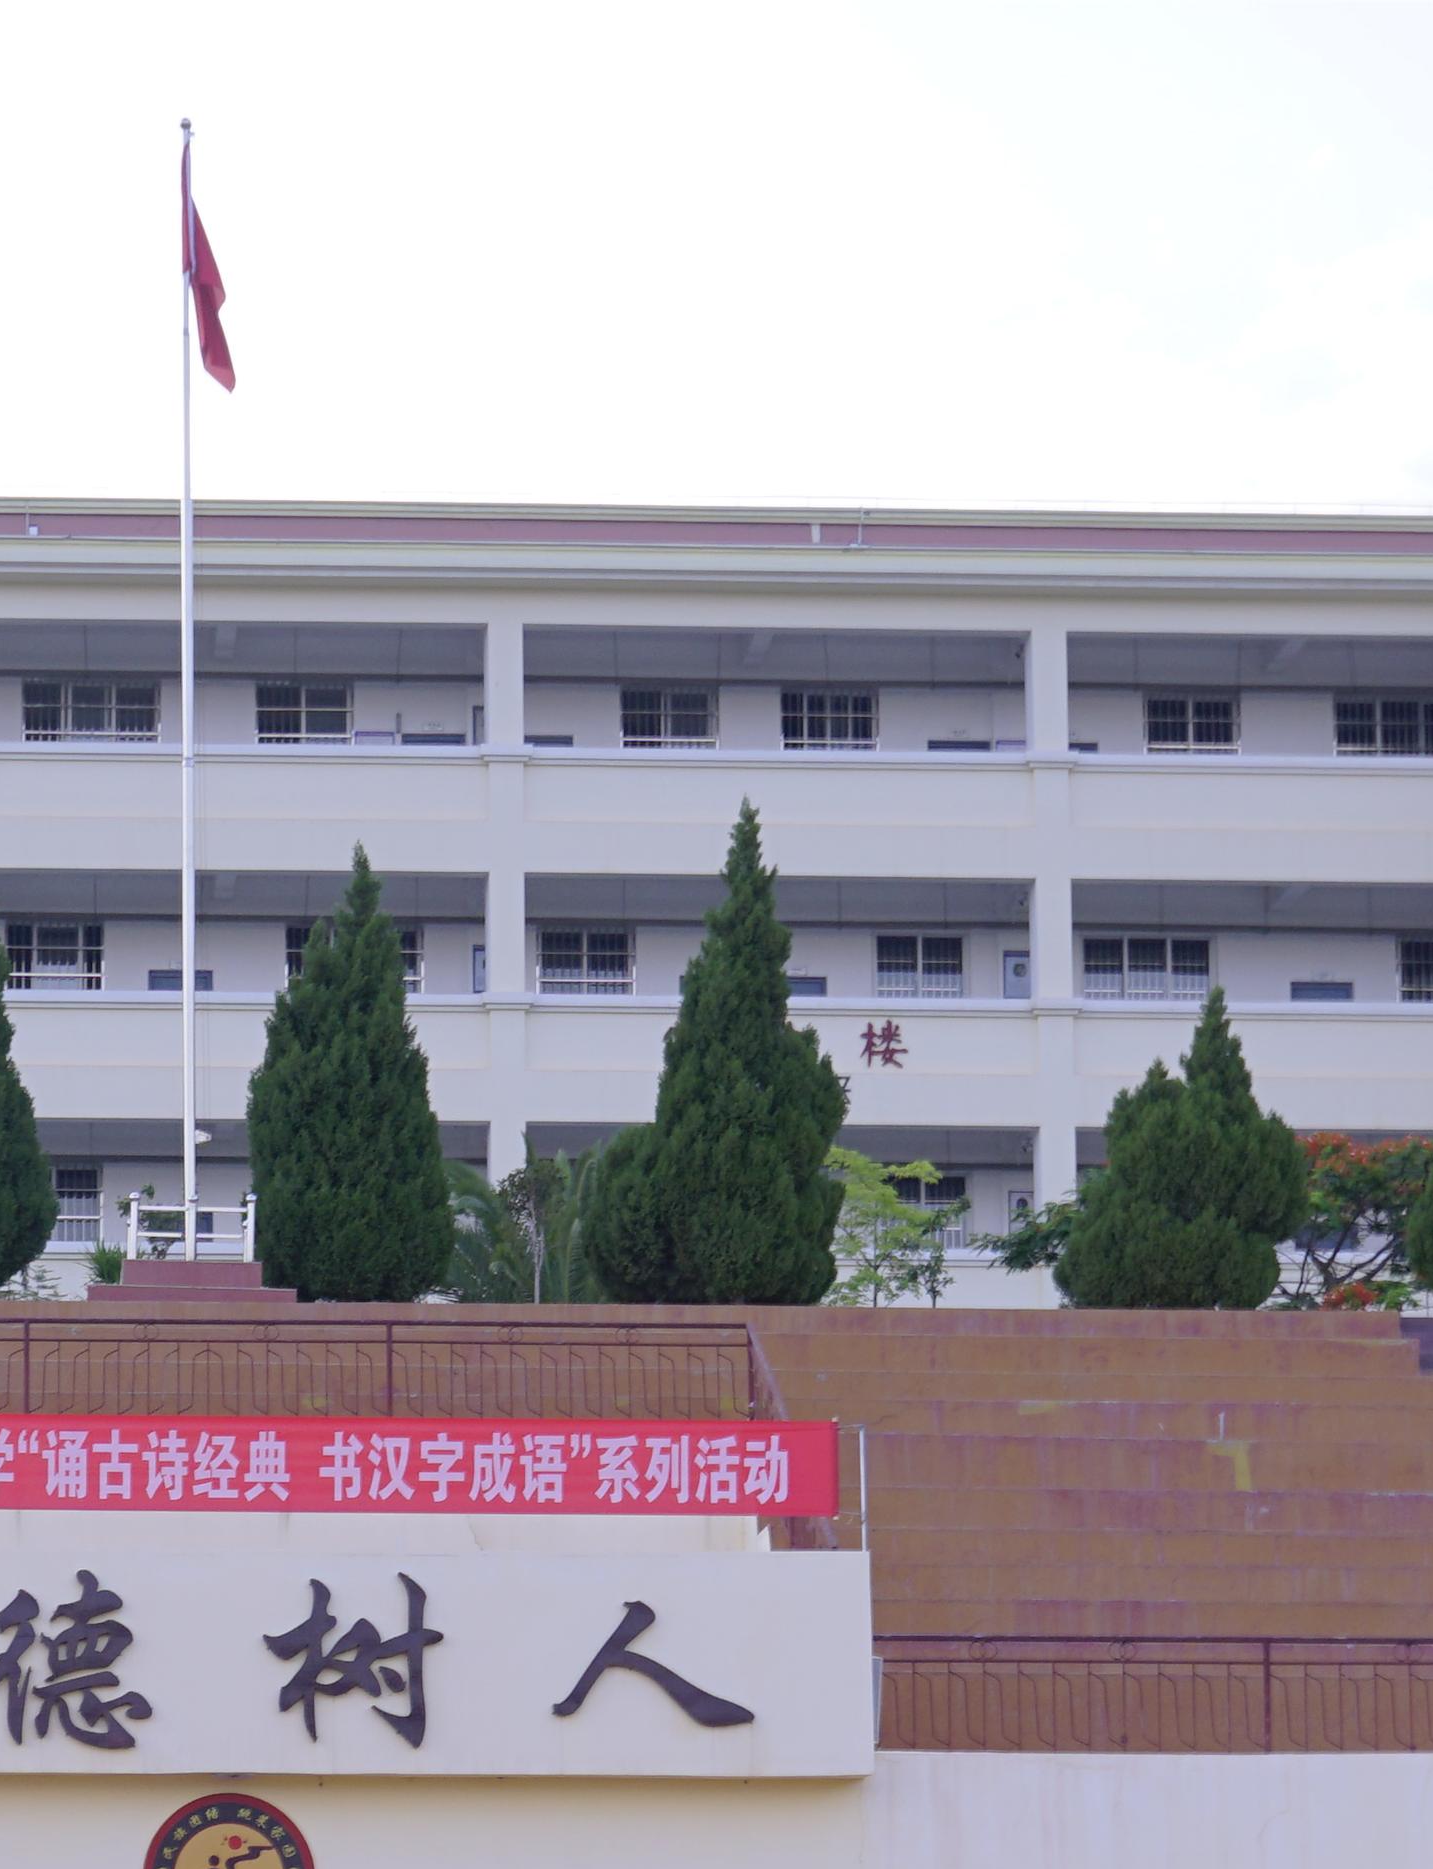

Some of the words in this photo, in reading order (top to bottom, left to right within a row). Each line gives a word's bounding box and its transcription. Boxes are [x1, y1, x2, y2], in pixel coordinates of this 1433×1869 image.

[860, 1019, 910, 1069] 楼
[319, 1430, 789, 1504] 书汉字成语”系列活动
